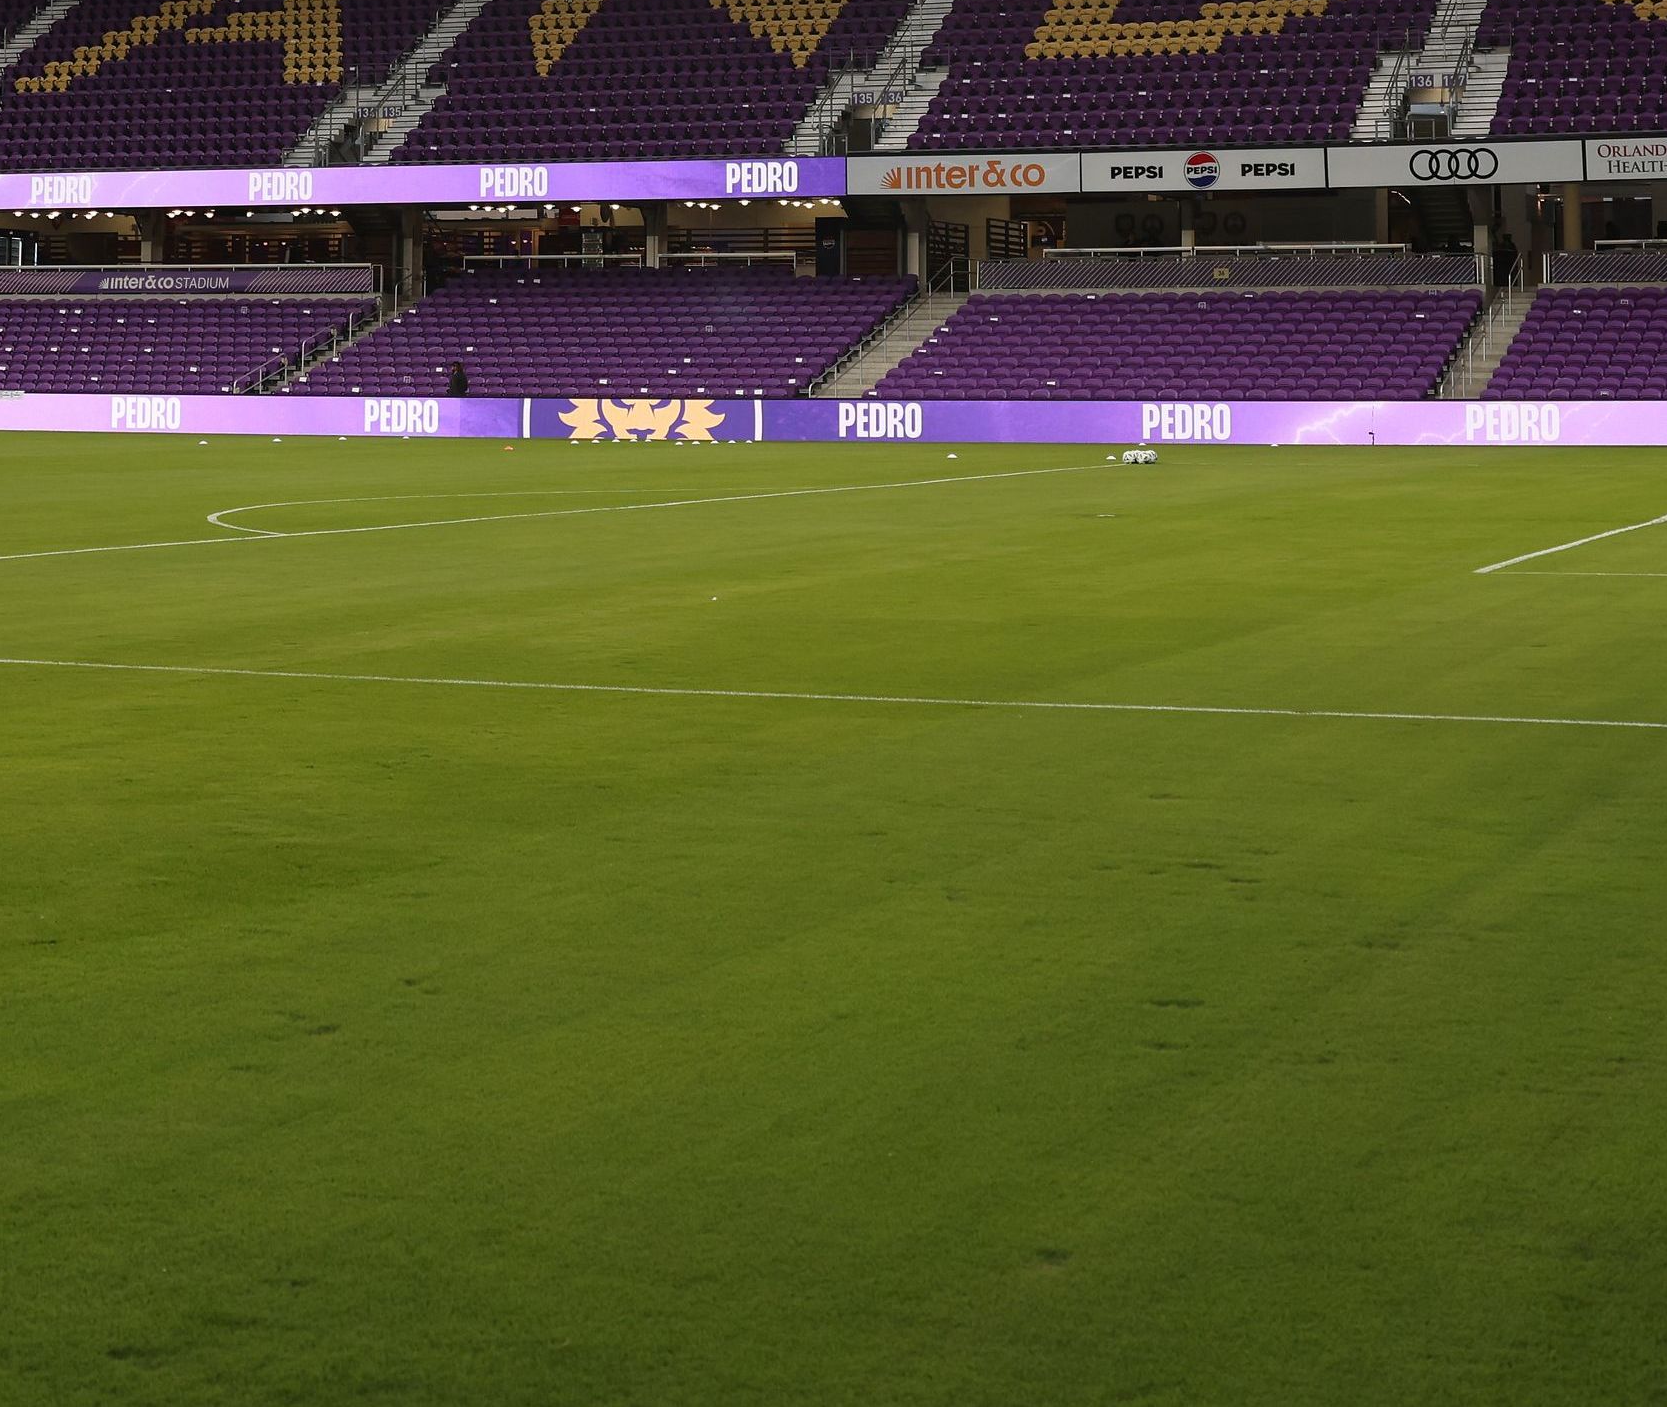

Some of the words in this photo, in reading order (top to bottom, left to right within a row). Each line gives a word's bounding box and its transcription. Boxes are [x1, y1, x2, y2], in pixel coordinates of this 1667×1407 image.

[1410, 75, 1434, 88] 136
[383, 106, 402, 118] 135
[852, 93, 873, 105] 135
[480, 166, 548, 197] PEDRO
[727, 161, 797, 193] PEDRO
[906, 160, 1045, 189] inter&co
[1110, 165, 1164, 180] PEPSI
[1186, 166, 1217, 175] PEPSI
[1240, 162, 1295, 177] PEPSI
[30, 175, 92, 205] PEDRO
[249, 171, 313, 202] PEDRO
[110, 275, 174, 290] inter&co
[174, 276, 230, 290] STADIUM
[108, 395, 181, 430] PEDRO
[365, 398, 439, 433] PEDRO
[839, 402, 923, 439] PEDRO
[1142, 402, 1231, 441] PEDRO
[1465, 402, 1562, 443] PEDRO
